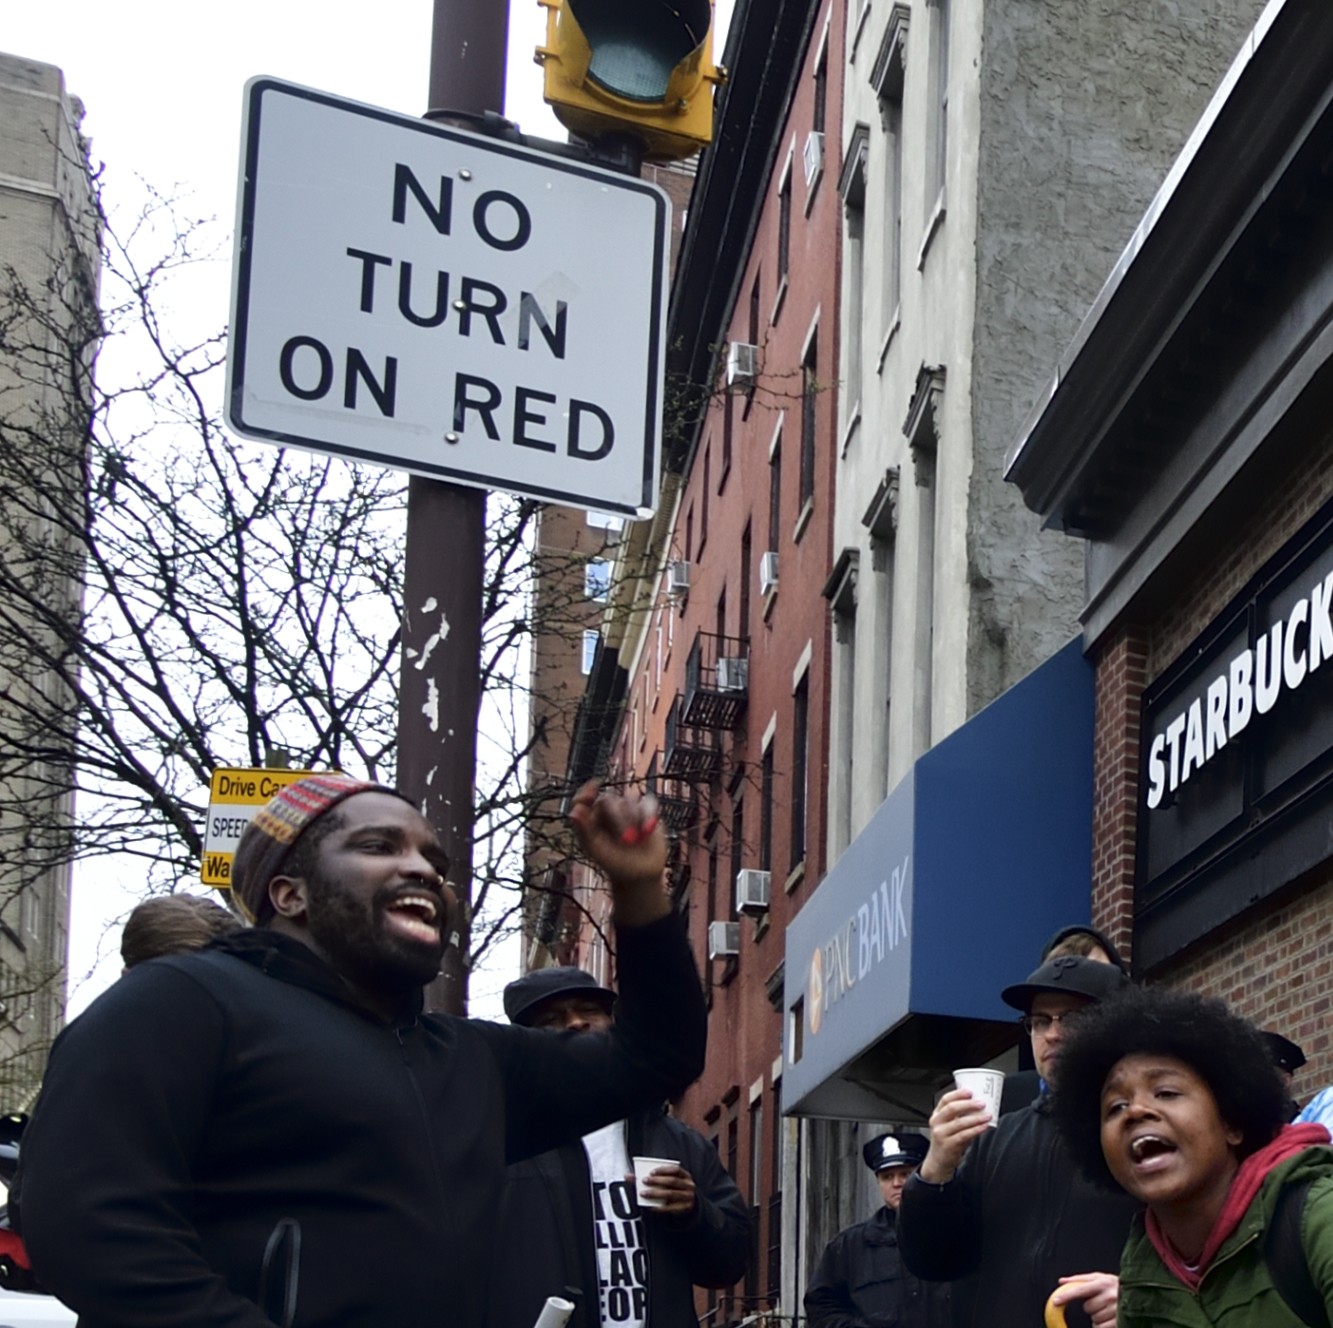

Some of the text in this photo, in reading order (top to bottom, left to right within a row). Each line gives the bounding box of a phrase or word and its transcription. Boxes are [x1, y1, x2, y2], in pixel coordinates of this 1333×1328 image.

[392, 163, 531, 252] NO
[347, 247, 568, 360] TURN
[279, 335, 615, 461] ON RED
[219, 776, 255, 797] Drive
[824, 855, 909, 1013] PNC BANK
